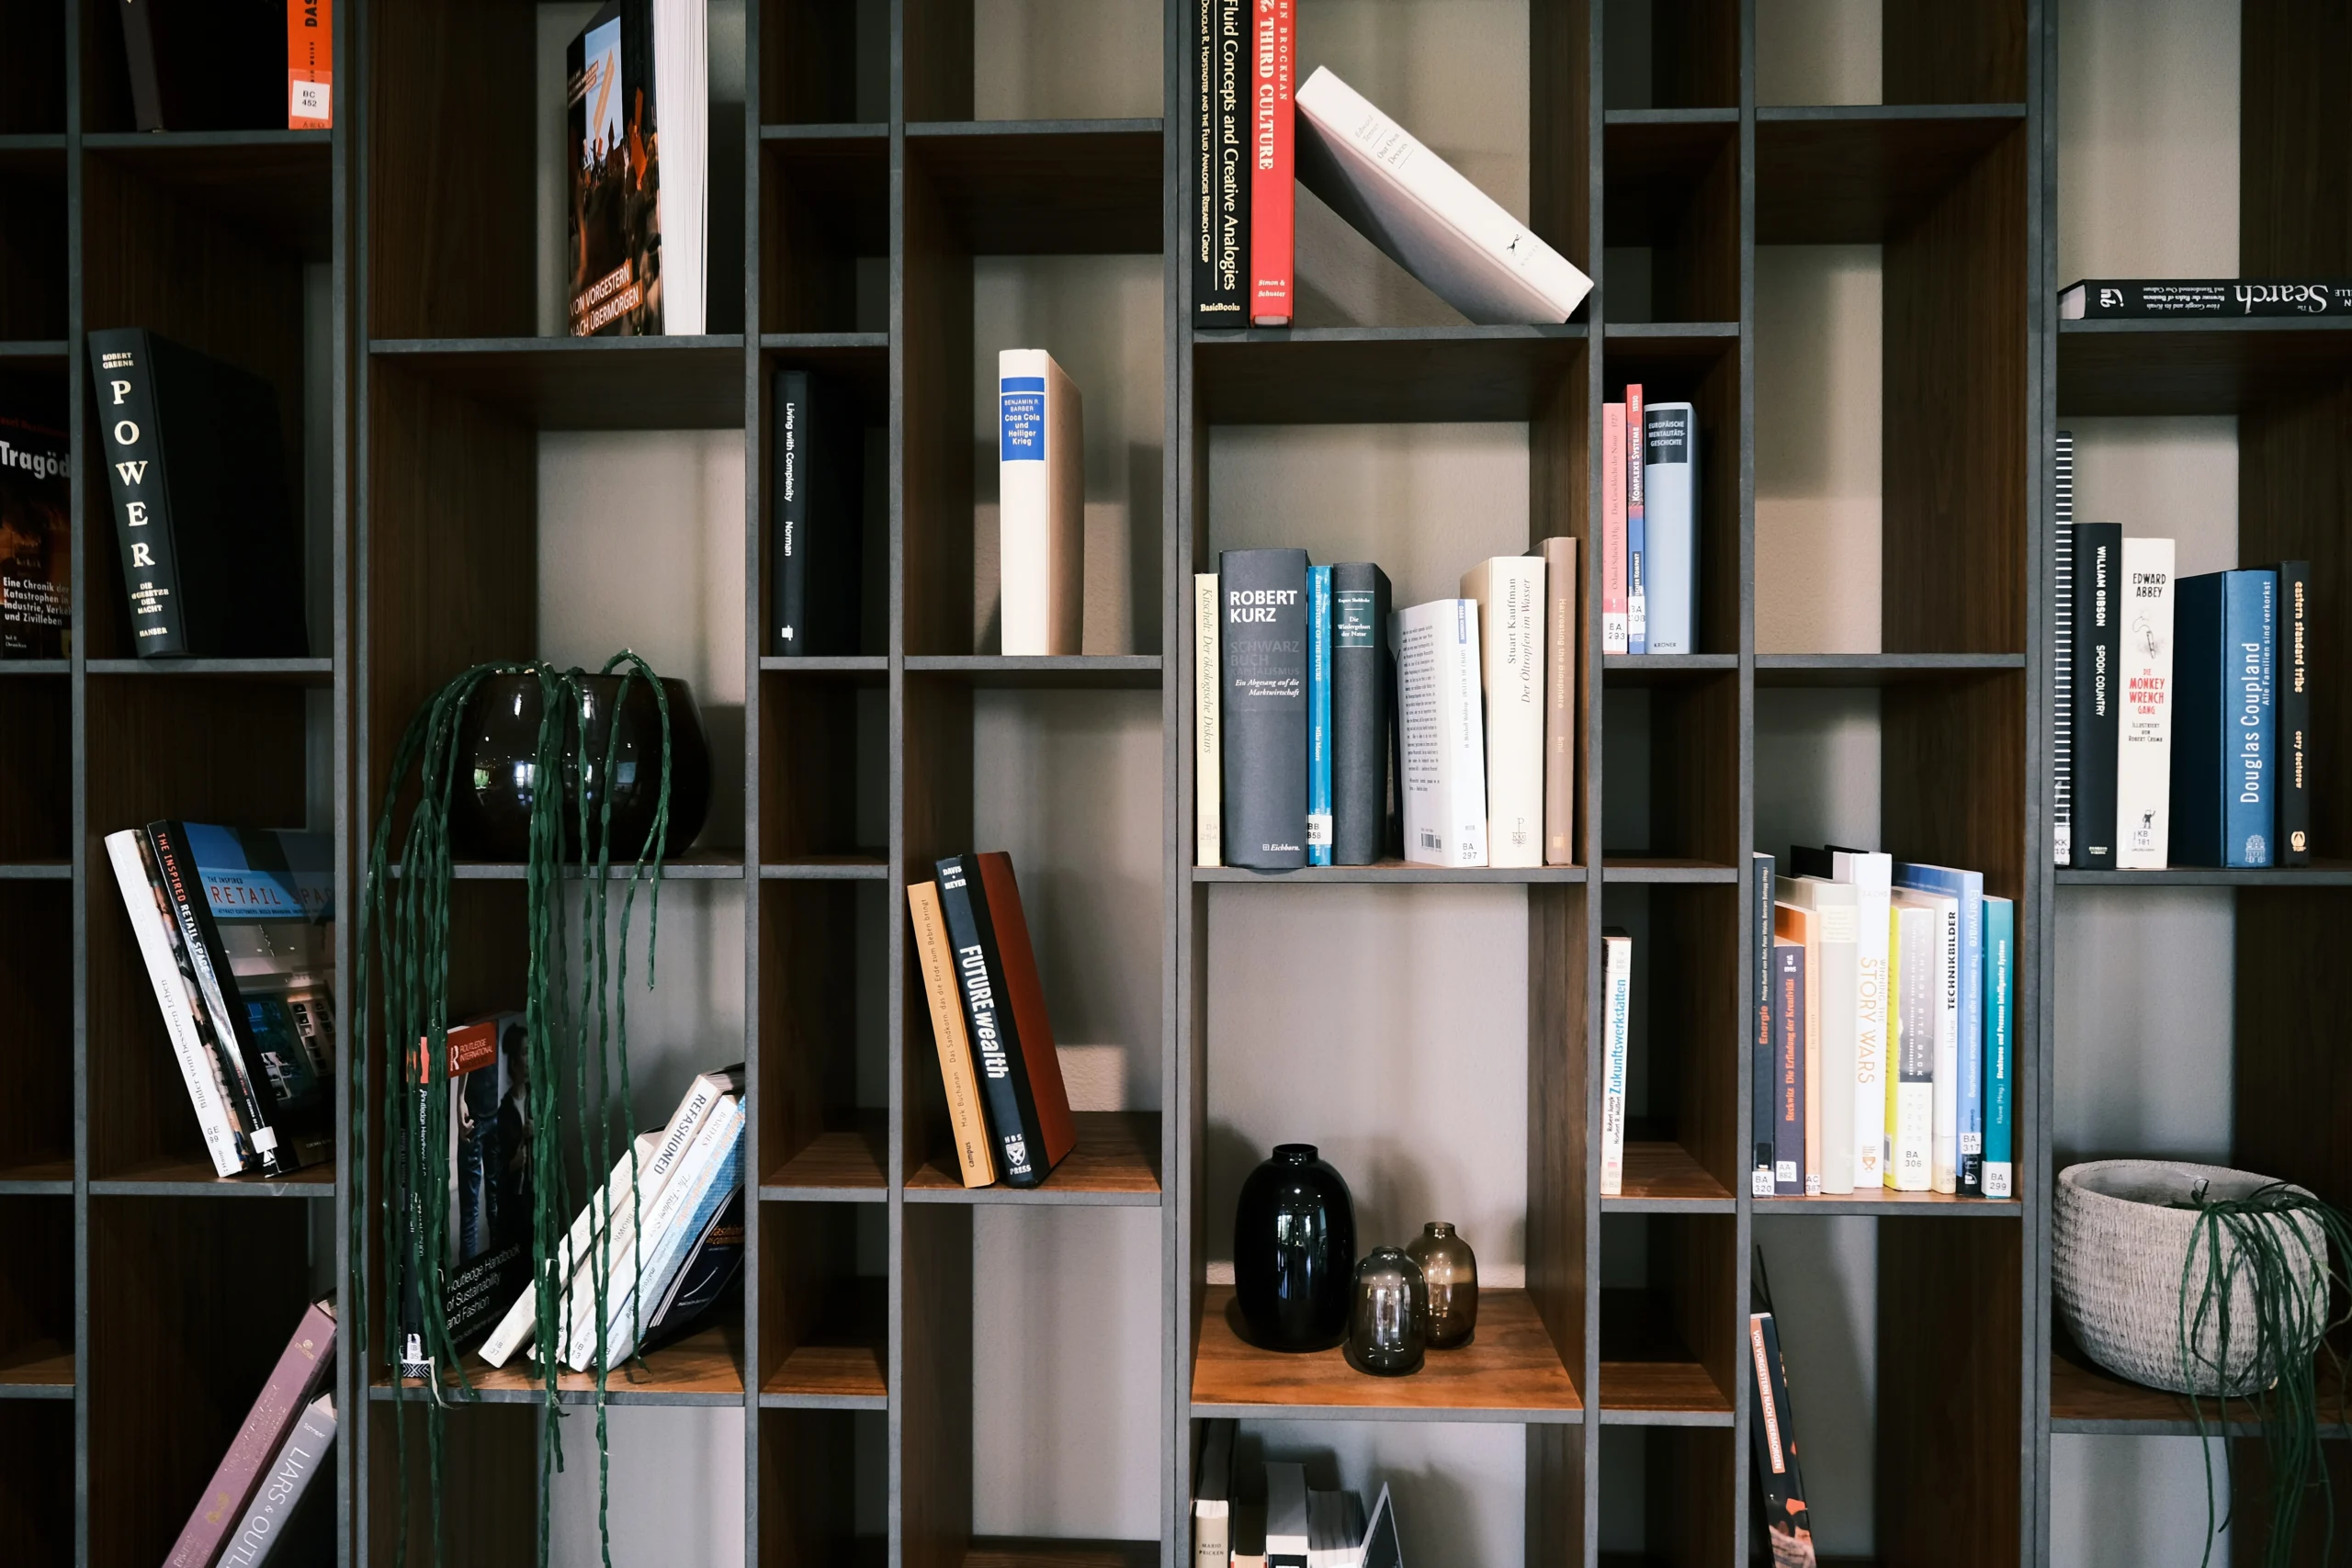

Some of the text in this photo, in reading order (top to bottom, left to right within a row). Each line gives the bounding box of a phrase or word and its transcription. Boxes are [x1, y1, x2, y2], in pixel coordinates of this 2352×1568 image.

[1202, 47, 1211, 94] HOFSTADTER
[1280, 28, 1288, 100] BROCKMAN
[302, 99, 317, 107] 452
[1260, 17, 1274, 170] THIRD CULTURE
[1202, 129, 1211, 151] FLUID
[1219, 39, 1239, 290] Concepts and Creative Analogies
[1388, 143, 1408, 164] Devices
[1202, 152, 1210, 195] ANALOGIES
[1202, 196, 1210, 232] RESEARCH
[1202, 234, 1211, 263] GROUP
[570, 265, 629, 317] VON VORGESTERN
[2233, 284, 2328, 314] Search
[591, 285, 639, 331] ÜBERMORGEN
[1200, 303, 1240, 312] BasicBooks
[1009, 430, 1036, 438] Heiliger
[1012, 438, 1032, 446] Krieg
[1650, 438, 1683, 447] GESCHICHTE
[110, 379, 156, 569] POWER
[784, 402, 795, 556] Living with Complexity Norman
[2132, 572, 2166, 585] EDWARD
[1230, 590, 1297, 606] ROBERT
[2136, 586, 2163, 598] ABBEY
[23, 613, 62, 626] Zivilleben
[1230, 607, 1276, 624] KURZ
[1508, 578, 1517, 664] Stuart Kauffman
[1519, 578, 1533, 704] Der Öltropfen im Wasser
[2095, 546, 2106, 716] WILLIAM GIBSON SPOOK COUNTRY
[1231, 640, 1299, 654] SCHWARZ
[1556, 598, 1567, 709] Harvesting Biosphere
[2262, 581, 2270, 706] Alle Familien sind verkorkst
[1231, 654, 1269, 667] BUCH
[1247, 679, 1276, 688] Abgesang
[1277, 678, 1290, 688] auf
[1249, 688, 1299, 698] Marktwirtschaft
[2129, 677, 2165, 690] MONKEY
[2293, 581, 2305, 789] eastern standard tribe cory doctorow
[1202, 636, 1214, 754] Der ökologische Diskurs
[2129, 691, 2165, 704] WRENCH
[2137, 705, 2155, 715] GANG
[2241, 642, 2263, 803] Douglas Coupland
[1463, 843, 1474, 852] BA
[1463, 851, 1477, 860] 297
[943, 866, 962, 876] DAVIS
[157, 832, 198, 941] THE INSPIRED RETAIL
[944, 878, 967, 889] MEYER
[210, 886, 281, 905] RETAIL
[921, 898, 932, 921] bringt
[1966, 888, 1980, 947] Everyware
[925, 922, 935, 945] Beben
[1947, 911, 1956, 1010] TECHNIKBILDER
[933, 965, 942, 982] Erde
[936, 984, 944, 996] die
[939, 998, 947, 1010] das
[960, 944, 1009, 1078] FUTURE wealth
[1758, 1006, 1770, 1044] Energie
[1858, 958, 1878, 1084] STORY WARS
[1609, 979, 1626, 1094] Zukunftswerkstätten
[948, 1050, 956, 1063] Das
[1785, 978, 1796, 1122] Reckwitz Die Erfindung der Kreativität
[953, 1071, 968, 1128] Mark Buchanan
[653, 1093, 707, 1176] REFASHIONED
[965, 1142, 975, 1168] campus
[1963, 1144, 1981, 1152] 317
[1010, 1165, 1031, 1175] PRESS
[1905, 1159, 1922, 1168] 306
[1755, 1175, 1768, 1184] BA
[1755, 1184, 1772, 1193] 320
[1990, 1181, 2007, 1190] 299
[1991, 1173, 2004, 1181] BA
[447, 1310, 461, 1330] and
[462, 1295, 490, 1321] Fashion
[1753, 1330, 1781, 1470] VON VORGESTERN NACH ÜBERMORGEN
[267, 1446, 311, 1505] LIARS
[264, 1505, 274, 1514] &
[226, 1515, 270, 1568] OUTL
